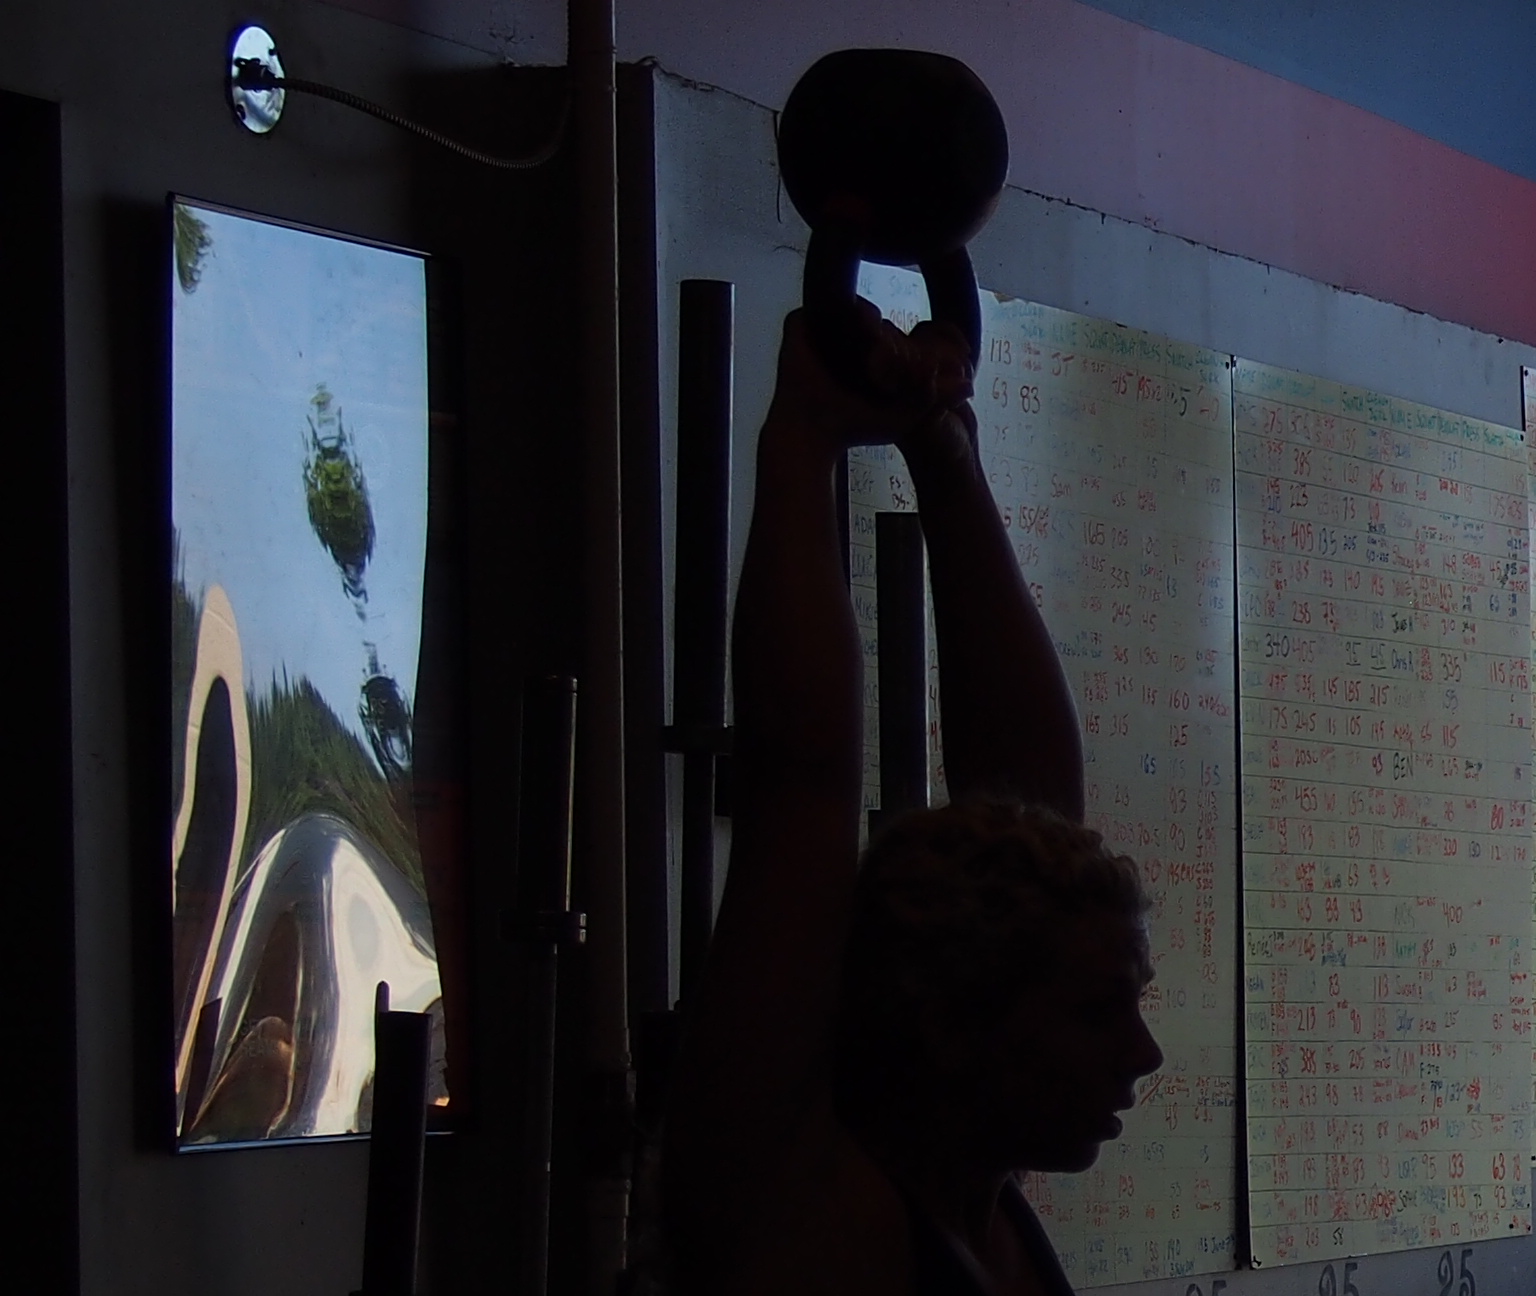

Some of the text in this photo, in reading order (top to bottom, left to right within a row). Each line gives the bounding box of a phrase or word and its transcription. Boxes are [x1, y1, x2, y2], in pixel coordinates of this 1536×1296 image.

[1020, 385, 1040, 414] 83
[1294, 448, 1312, 476] 385
[1083, 520, 1106, 546] 165
[1291, 521, 1314, 552] 405
[1319, 527, 1337, 556] 135
[1112, 602, 1131, 626] 245
[1292, 600, 1311, 624] 238
[1265, 632, 1290, 658] 340
[1441, 653, 1461, 682] 335
[1490, 661, 1506, 683] 115
[1169, 689, 1190, 711] 160
[1370, 683, 1390, 706] 215
[1269, 706, 1288, 729] 175
[1292, 709, 1317, 733] 245
[1346, 715, 1361, 736] 105
[1442, 724, 1460, 749] 115
[1140, 754, 1157, 775] 165
[1200, 760, 1221, 787] 155
[1392, 751, 1414, 780] BEN
[1294, 785, 1318, 812] 455
[1348, 863, 1359, 887] 63
[1442, 902, 1463, 928] 400
[1297, 1006, 1316, 1031] 213
[1421, 1153, 1437, 1180] 95
[1492, 1153, 1506, 1181] 63
